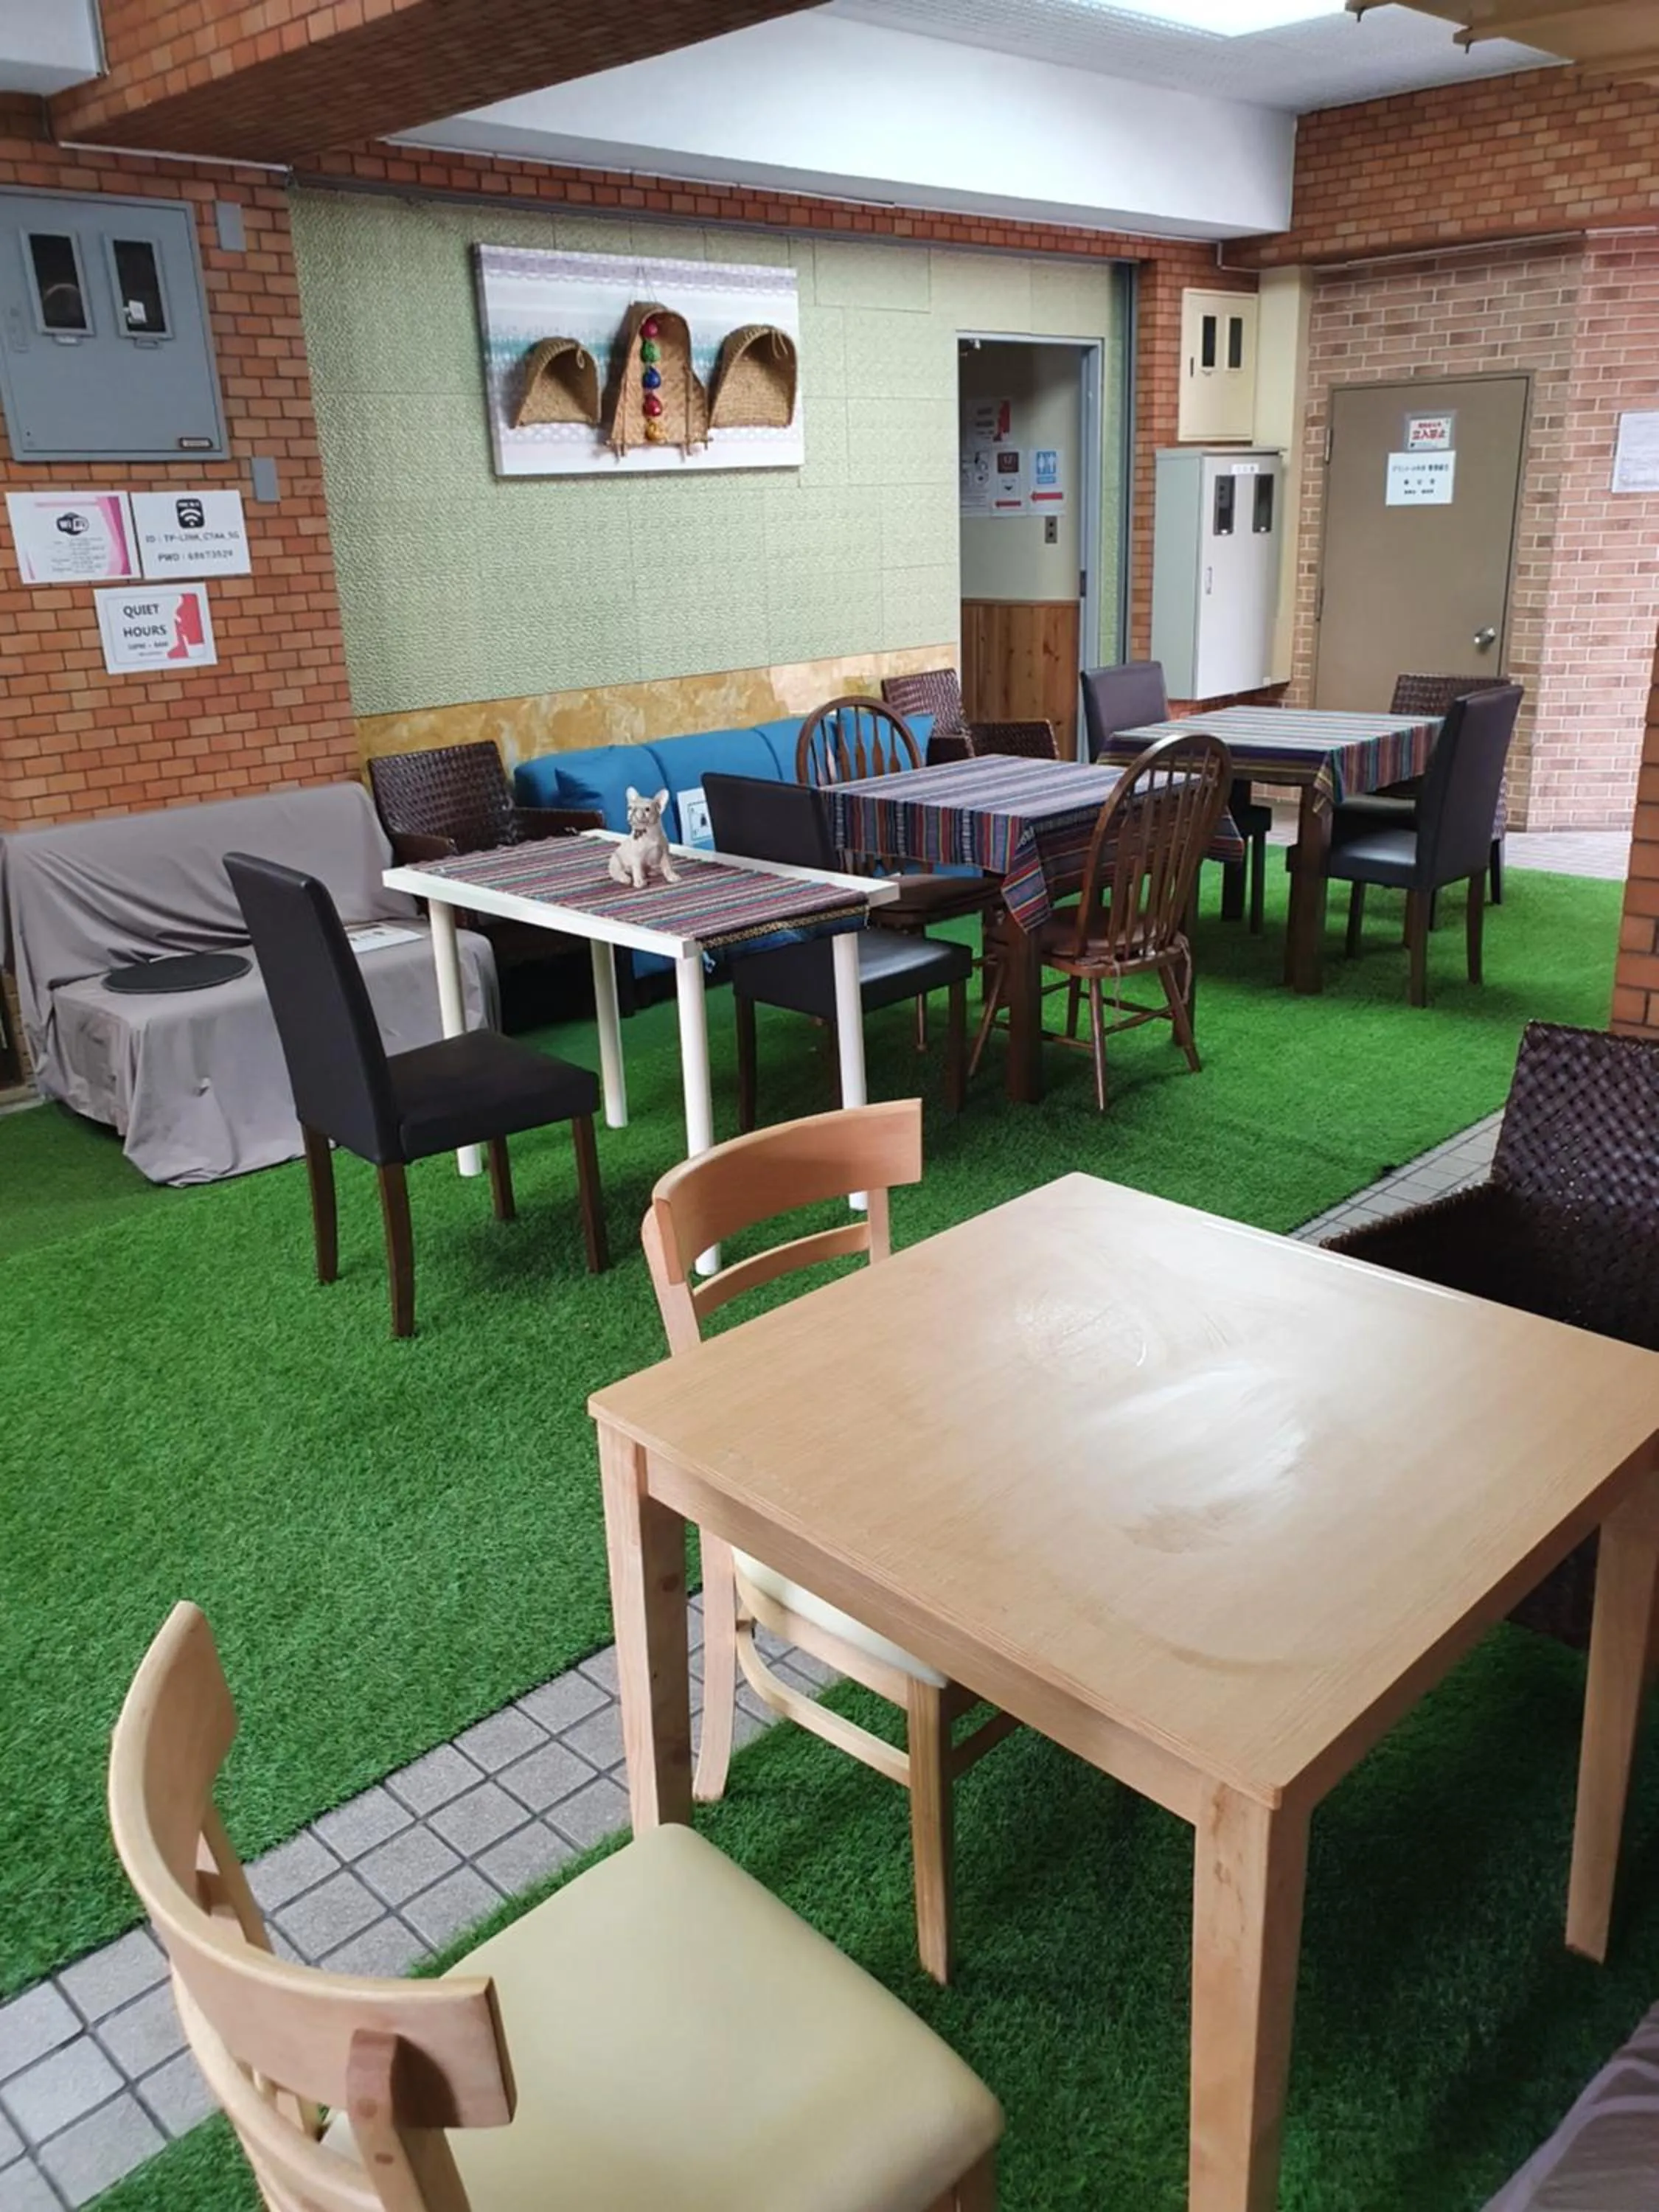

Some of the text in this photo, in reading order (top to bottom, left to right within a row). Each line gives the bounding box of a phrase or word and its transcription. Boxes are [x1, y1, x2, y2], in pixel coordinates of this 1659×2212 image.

[145, 535, 156, 543] ID
[158, 552, 179, 561] PWD
[122, 603, 160, 619] QUIET
[123, 625, 167, 637] HOURS
